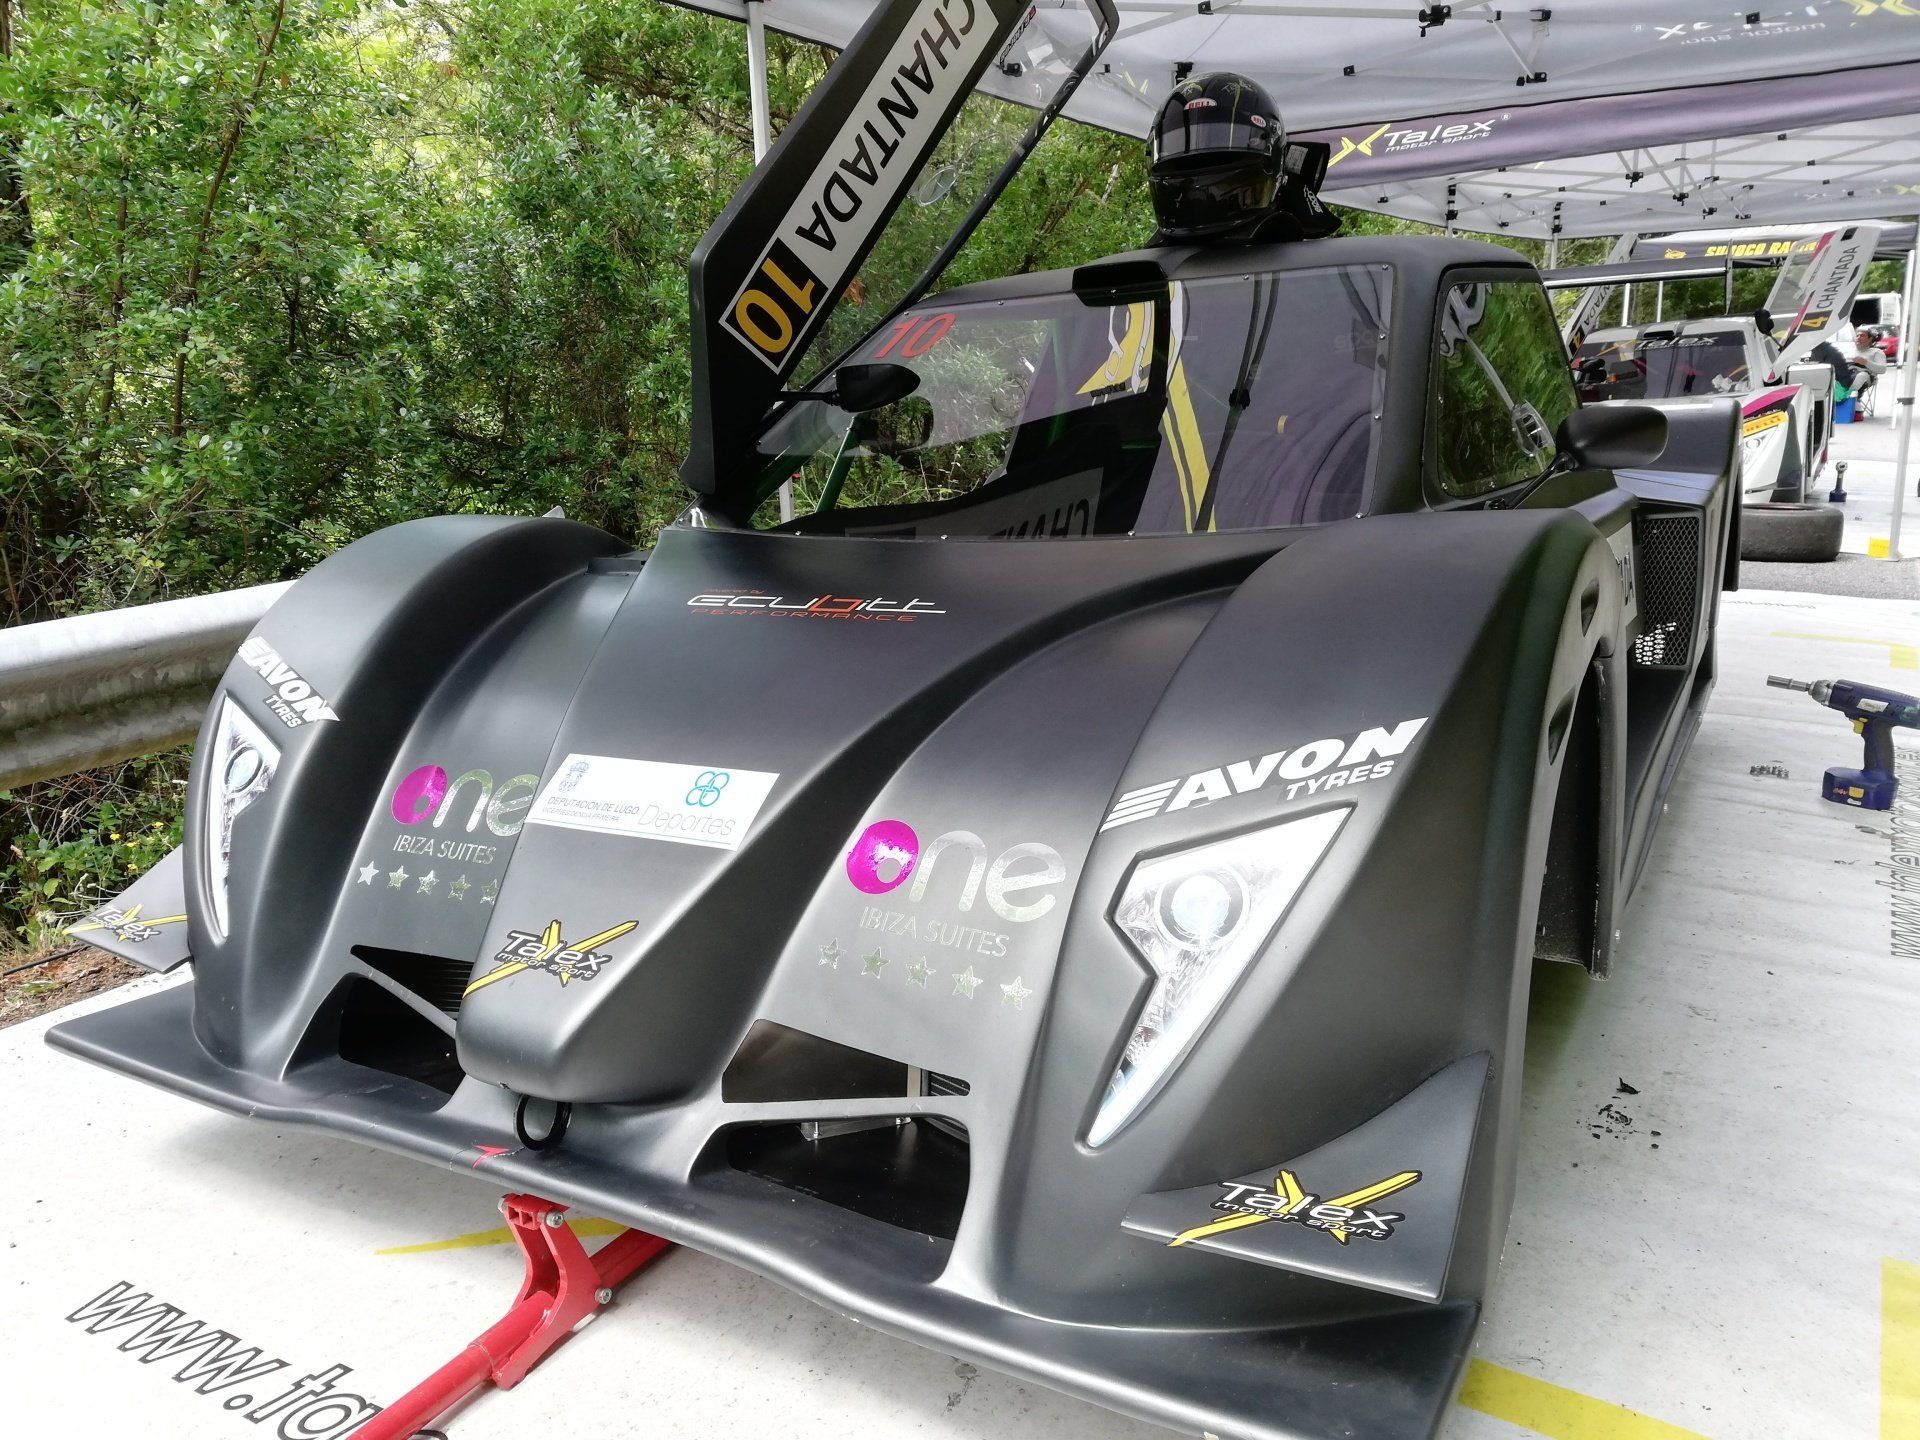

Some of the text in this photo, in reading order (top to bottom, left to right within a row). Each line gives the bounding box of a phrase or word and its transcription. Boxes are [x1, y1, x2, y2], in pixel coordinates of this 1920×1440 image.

[795, 0, 976, 252] CHANTADA
[1384, 119, 1496, 146] Talex
[1385, 131, 1491, 153] motor sport
[1816, 245, 1861, 309] CHANTADA
[735, 257, 817, 354] 10
[1802, 316, 1829, 328] 4
[874, 312, 957, 360] 10
[691, 608, 917, 622] PERFORMANCE
[252, 651, 340, 722] AVON
[265, 694, 303, 729] TYRES
[1165, 716, 1429, 813] AVON
[1286, 760, 1394, 801] TYRES
[614, 804, 640, 815] LUGO
[637, 804, 736, 837] Deportes
[393, 834, 497, 865] IBIZA SUITES
[846, 819, 1067, 922] one
[96, 905, 160, 939] Talex
[859, 906, 1010, 957] IBIZA SUITES
[497, 951, 597, 978] motor sport
[504, 932, 609, 970] Talex
[1213, 1200, 1387, 1238] motor sport
[1221, 1181, 1399, 1230] Talex
